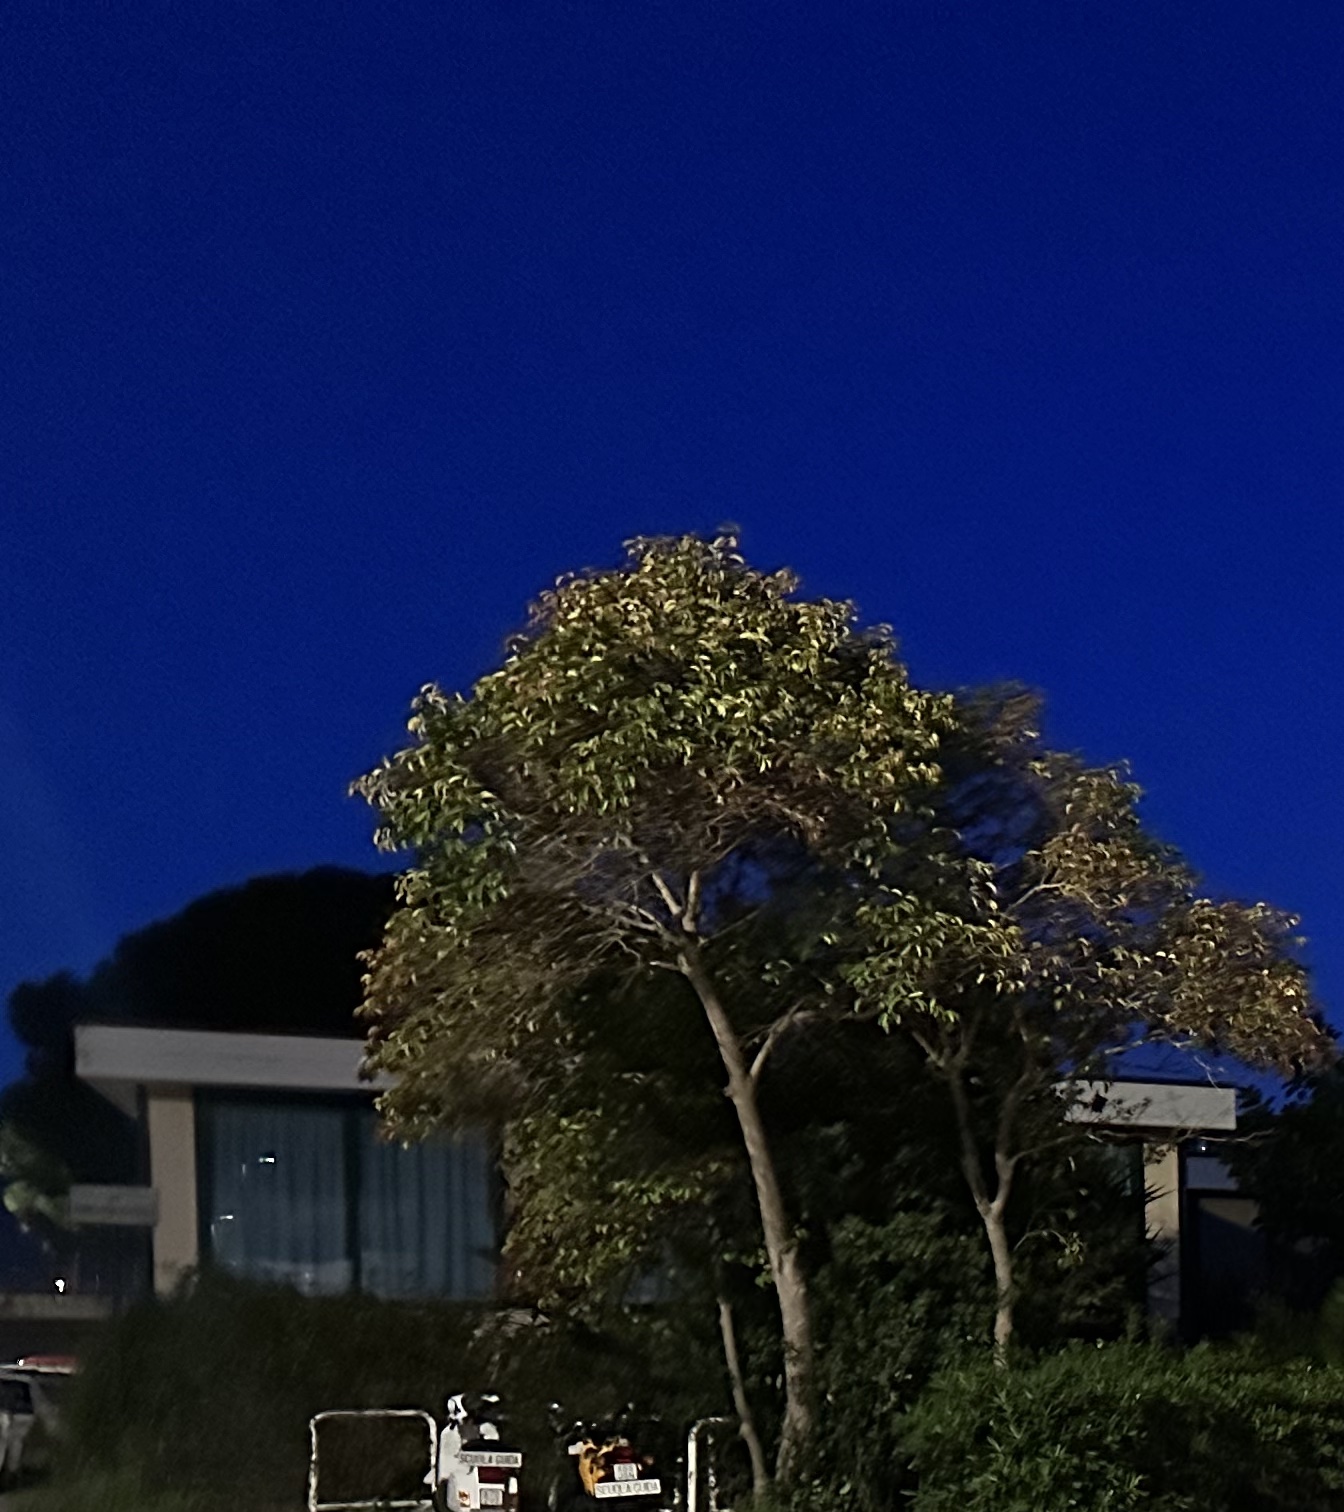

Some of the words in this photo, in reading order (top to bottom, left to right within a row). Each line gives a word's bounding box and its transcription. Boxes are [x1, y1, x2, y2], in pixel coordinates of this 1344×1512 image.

[459, 1453, 493, 1464] SCUOLA
[596, 1483, 632, 1496] SCUOLA
[633, 1481, 659, 1493] GUIDA
